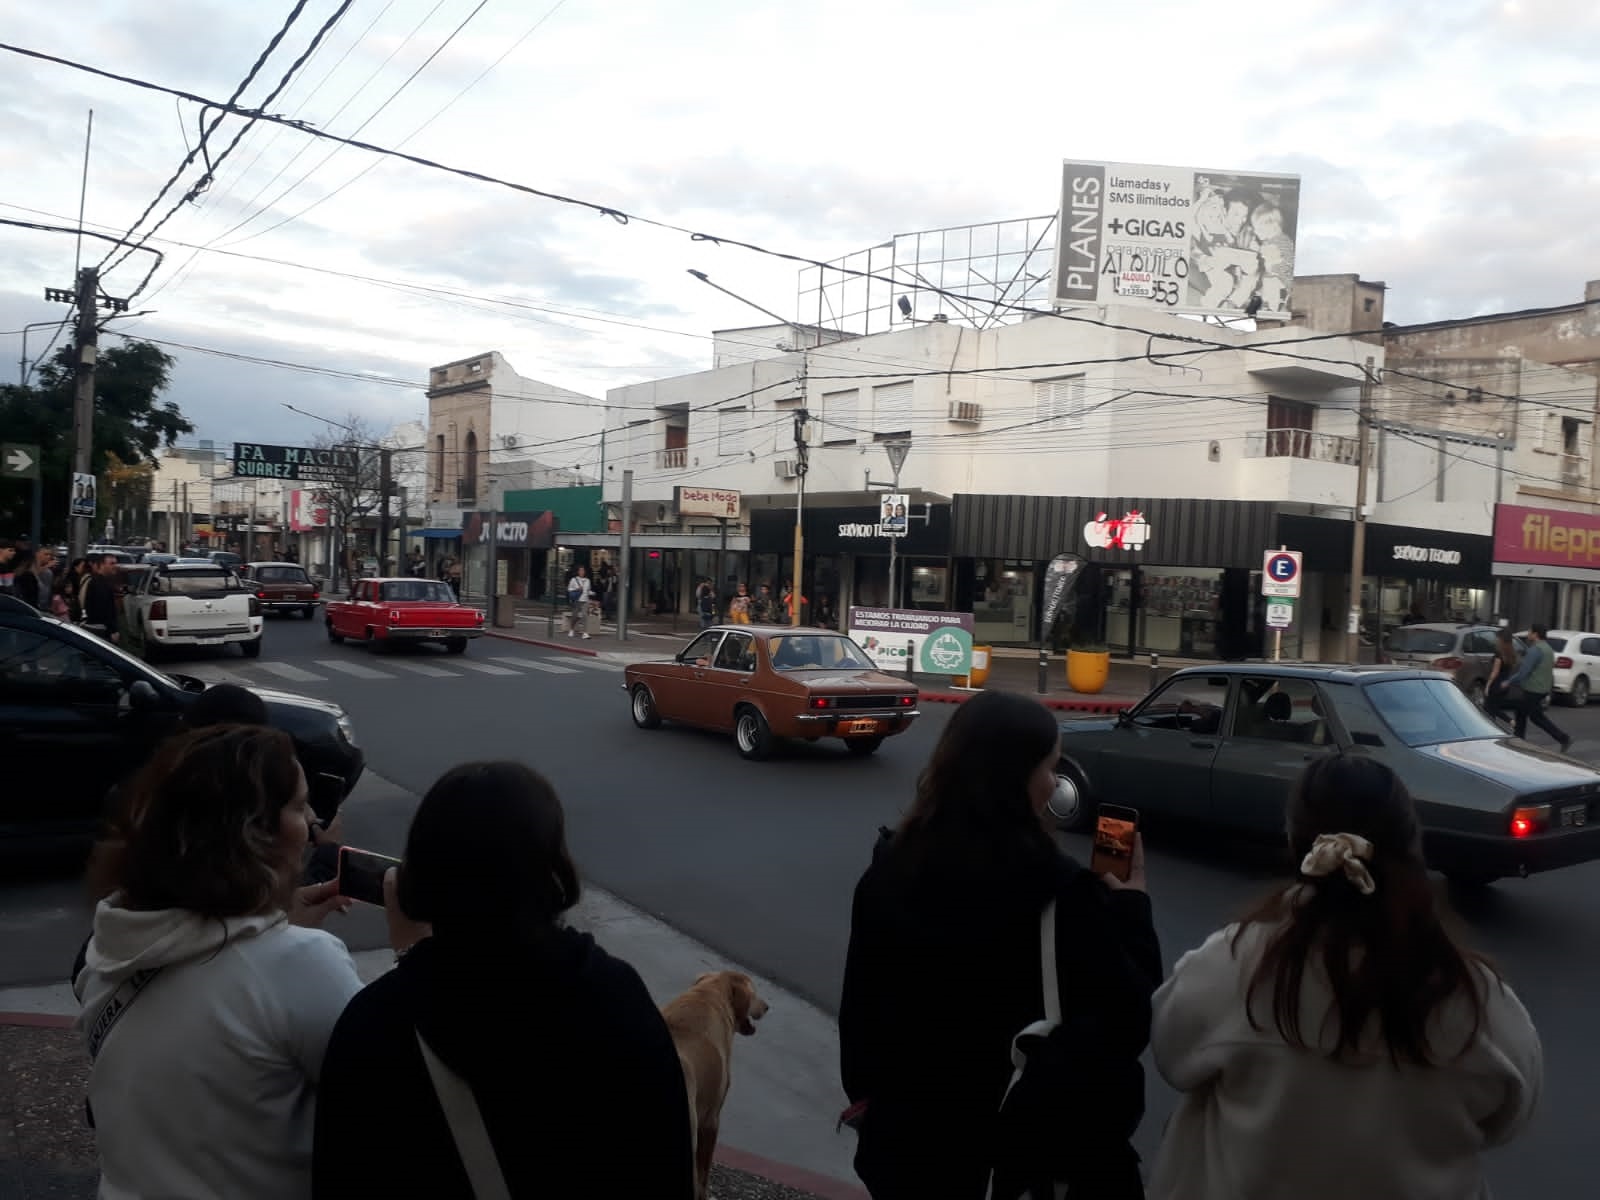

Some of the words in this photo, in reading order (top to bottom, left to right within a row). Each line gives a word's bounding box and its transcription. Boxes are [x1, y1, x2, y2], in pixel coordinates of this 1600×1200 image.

[1110, 177, 1161, 190] Llamadas
[1163, 182, 1170, 192] y
[1109, 192, 1135, 204] SMS
[1136, 194, 1190, 207] ilimitados
[1066, 177, 1100, 290] PLANES
[238, 461, 291, 478] SUAREZ
[1276, 560, 1289, 576] E
[855, 611, 891, 619] ESTAMOS
[892, 613, 940, 623] TRABAJANDO
[941, 616, 961, 624] PARA
[855, 619, 890, 628] MEJORAR
[901, 622, 929, 630] CIUDAD
